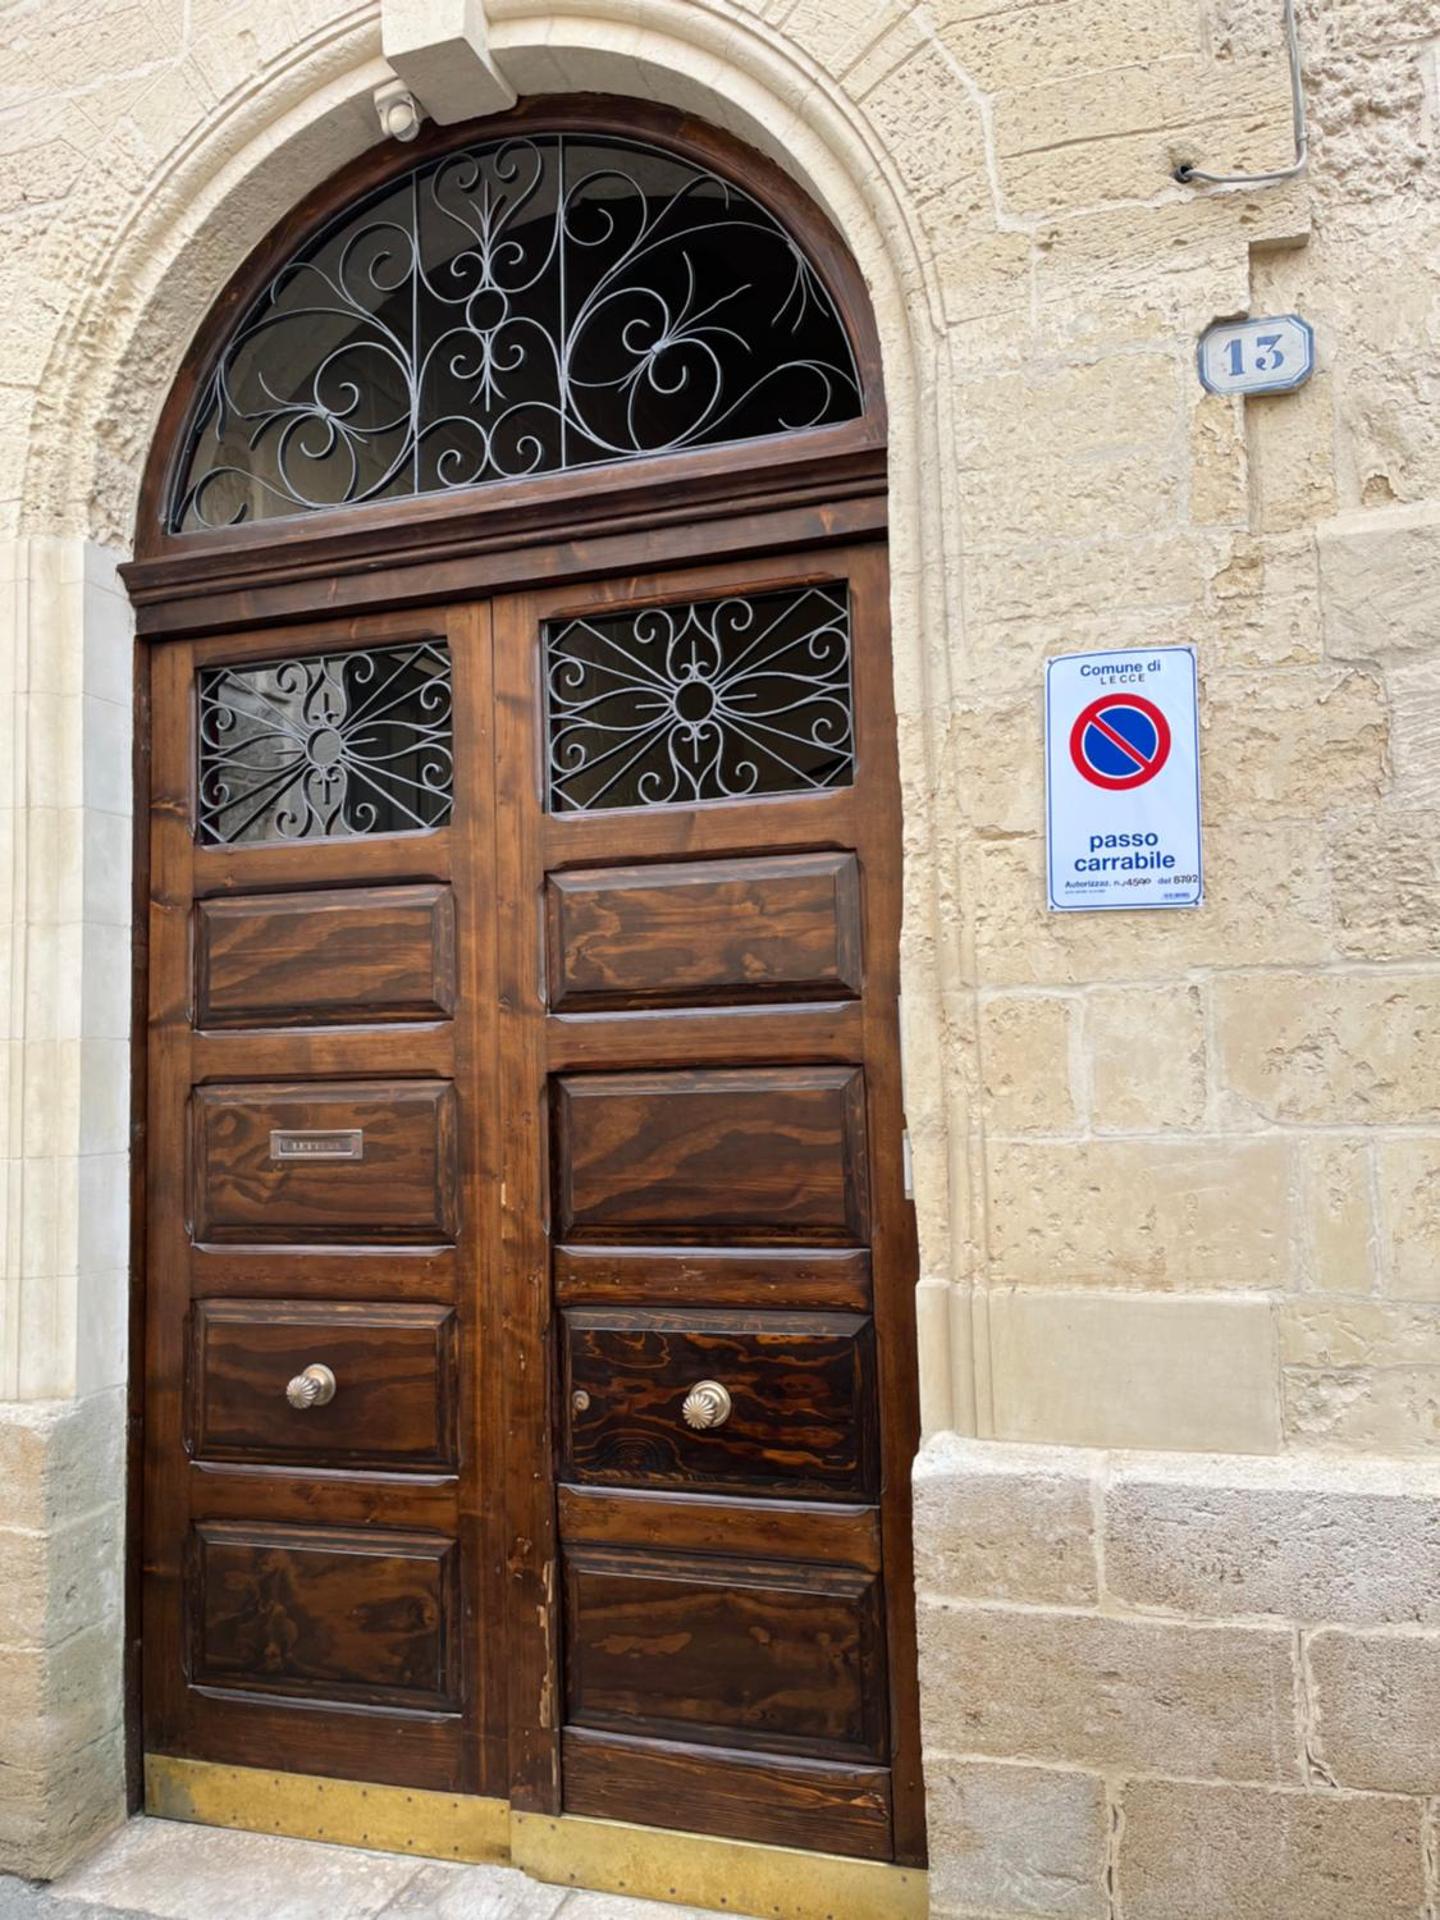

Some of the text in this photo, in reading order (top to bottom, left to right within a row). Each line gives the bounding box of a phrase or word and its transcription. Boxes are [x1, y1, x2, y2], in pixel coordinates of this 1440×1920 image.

[1223, 333, 1285, 377] 13
[1080, 659, 1161, 677] Comune di
[1100, 673, 1145, 685] LECCE
[1090, 832, 1158, 853] passo
[1074, 851, 1175, 872] carrabile
